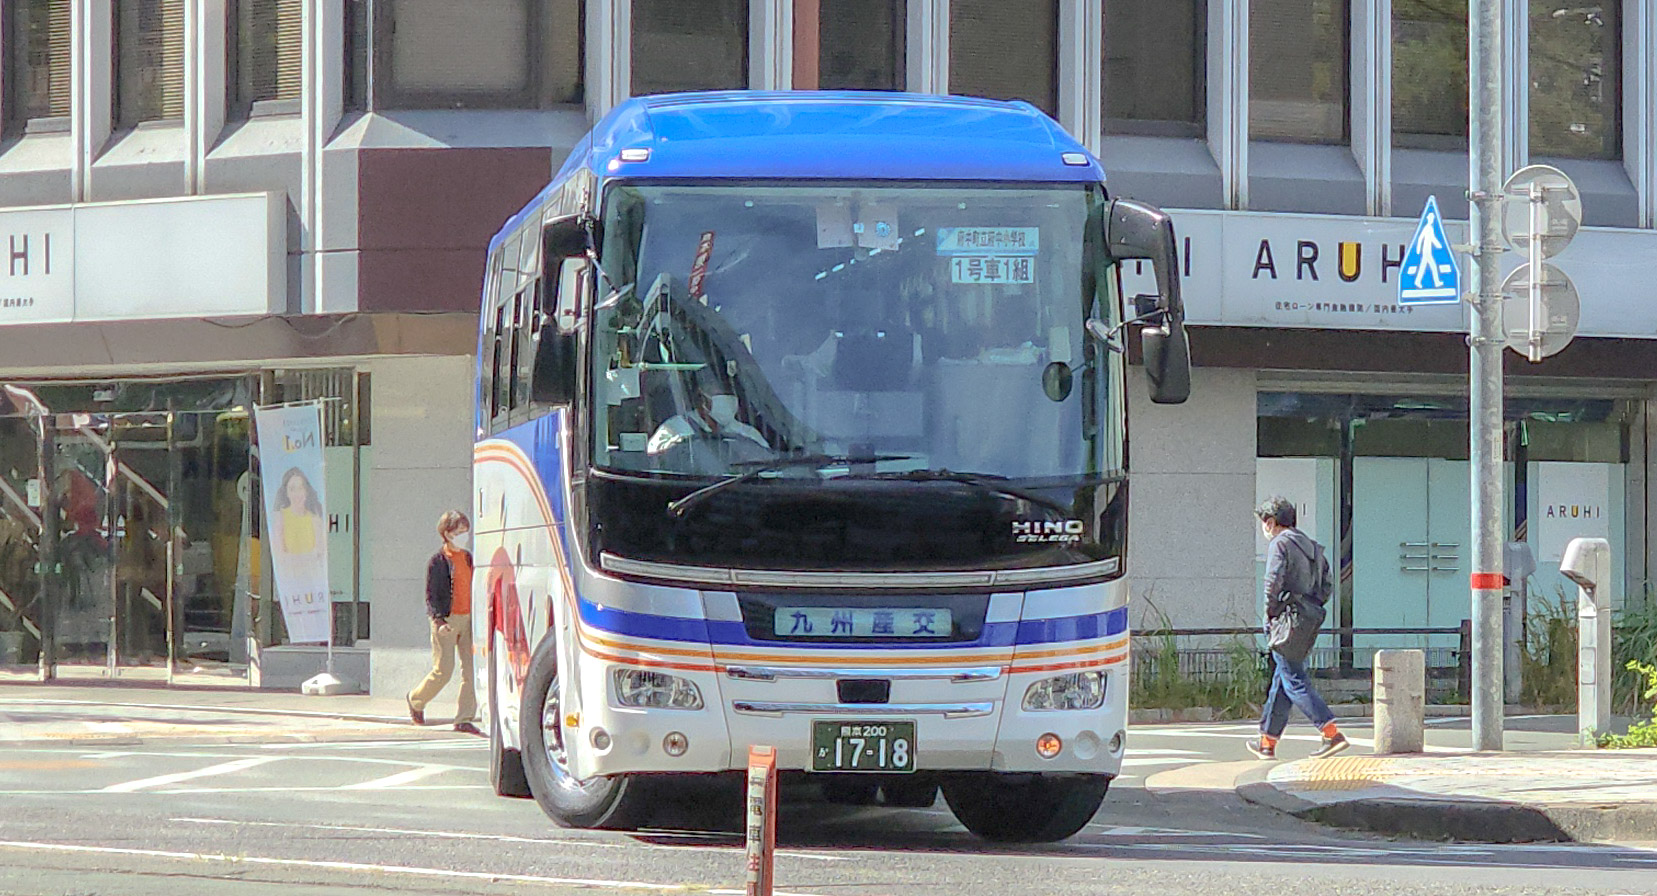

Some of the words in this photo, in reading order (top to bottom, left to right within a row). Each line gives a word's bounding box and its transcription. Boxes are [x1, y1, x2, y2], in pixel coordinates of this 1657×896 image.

[955, 259, 1029, 281] 1号車1組
[1251, 239, 1406, 283] ARUH
[1546, 504, 1600, 518] ARUHI
[1011, 520, 1084, 534] HINO
[1016, 534, 1080, 544] SELEGA
[790, 610, 936, 635] 九州産交
[835, 738, 908, 767] 17-18
